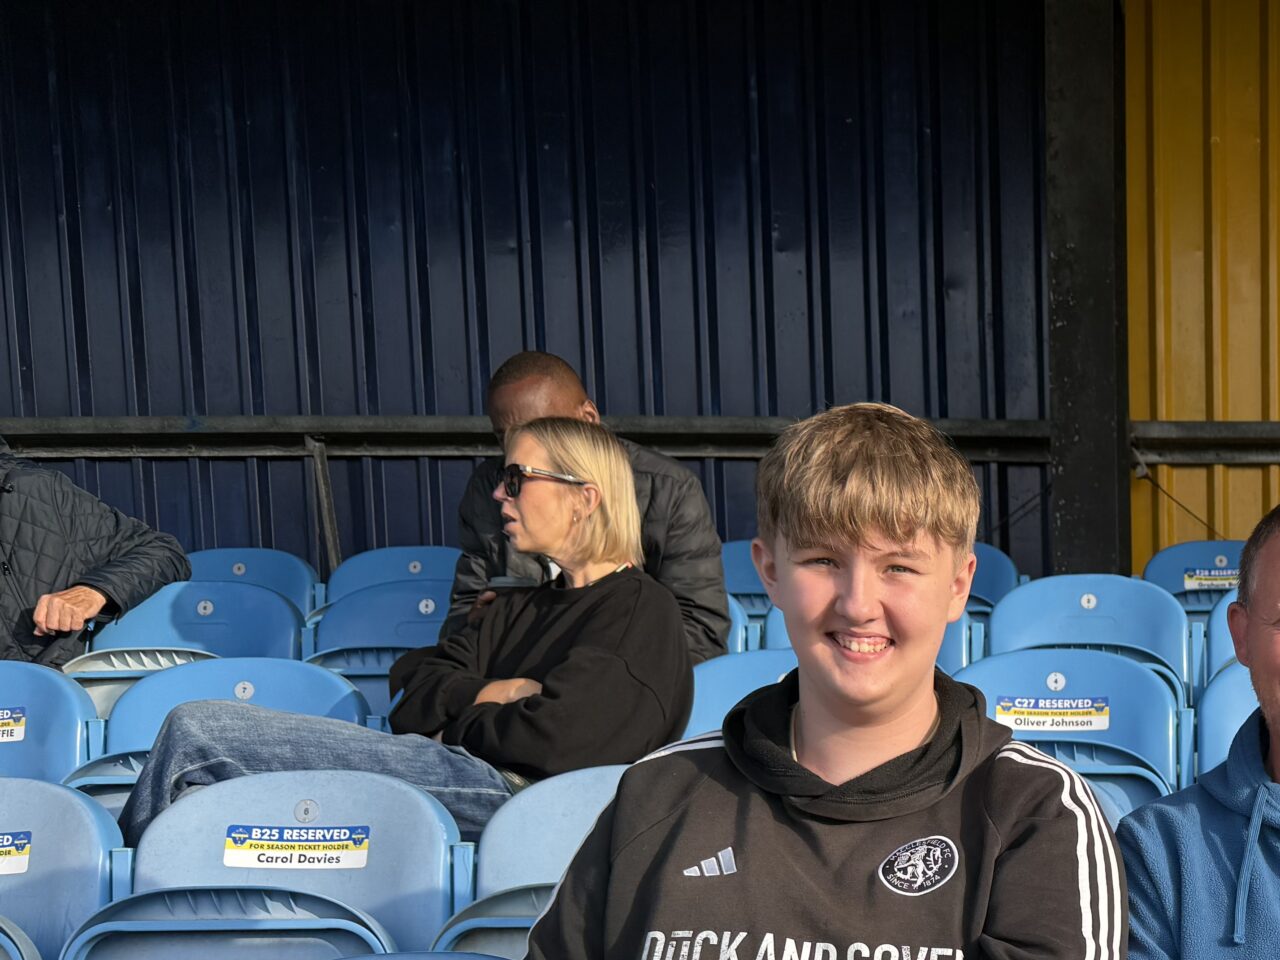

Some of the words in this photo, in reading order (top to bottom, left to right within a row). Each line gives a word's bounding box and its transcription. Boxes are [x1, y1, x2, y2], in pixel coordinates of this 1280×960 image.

[1014, 698, 1035, 708] C27
[1038, 698, 1092, 708] RESERVED
[1014, 717, 1047, 727] Oliver
[1050, 718, 1093, 727] Johnson
[303, 807, 310, 816] 6
[251, 828, 280, 840] B25
[283, 828, 350, 841] RESERVED
[257, 853, 293, 864] Carol
[298, 853, 341, 864] Davies
[943, 848, 952, 859] FC
[886, 873, 910, 890] SINCE
[922, 874, 941, 888] 1874
